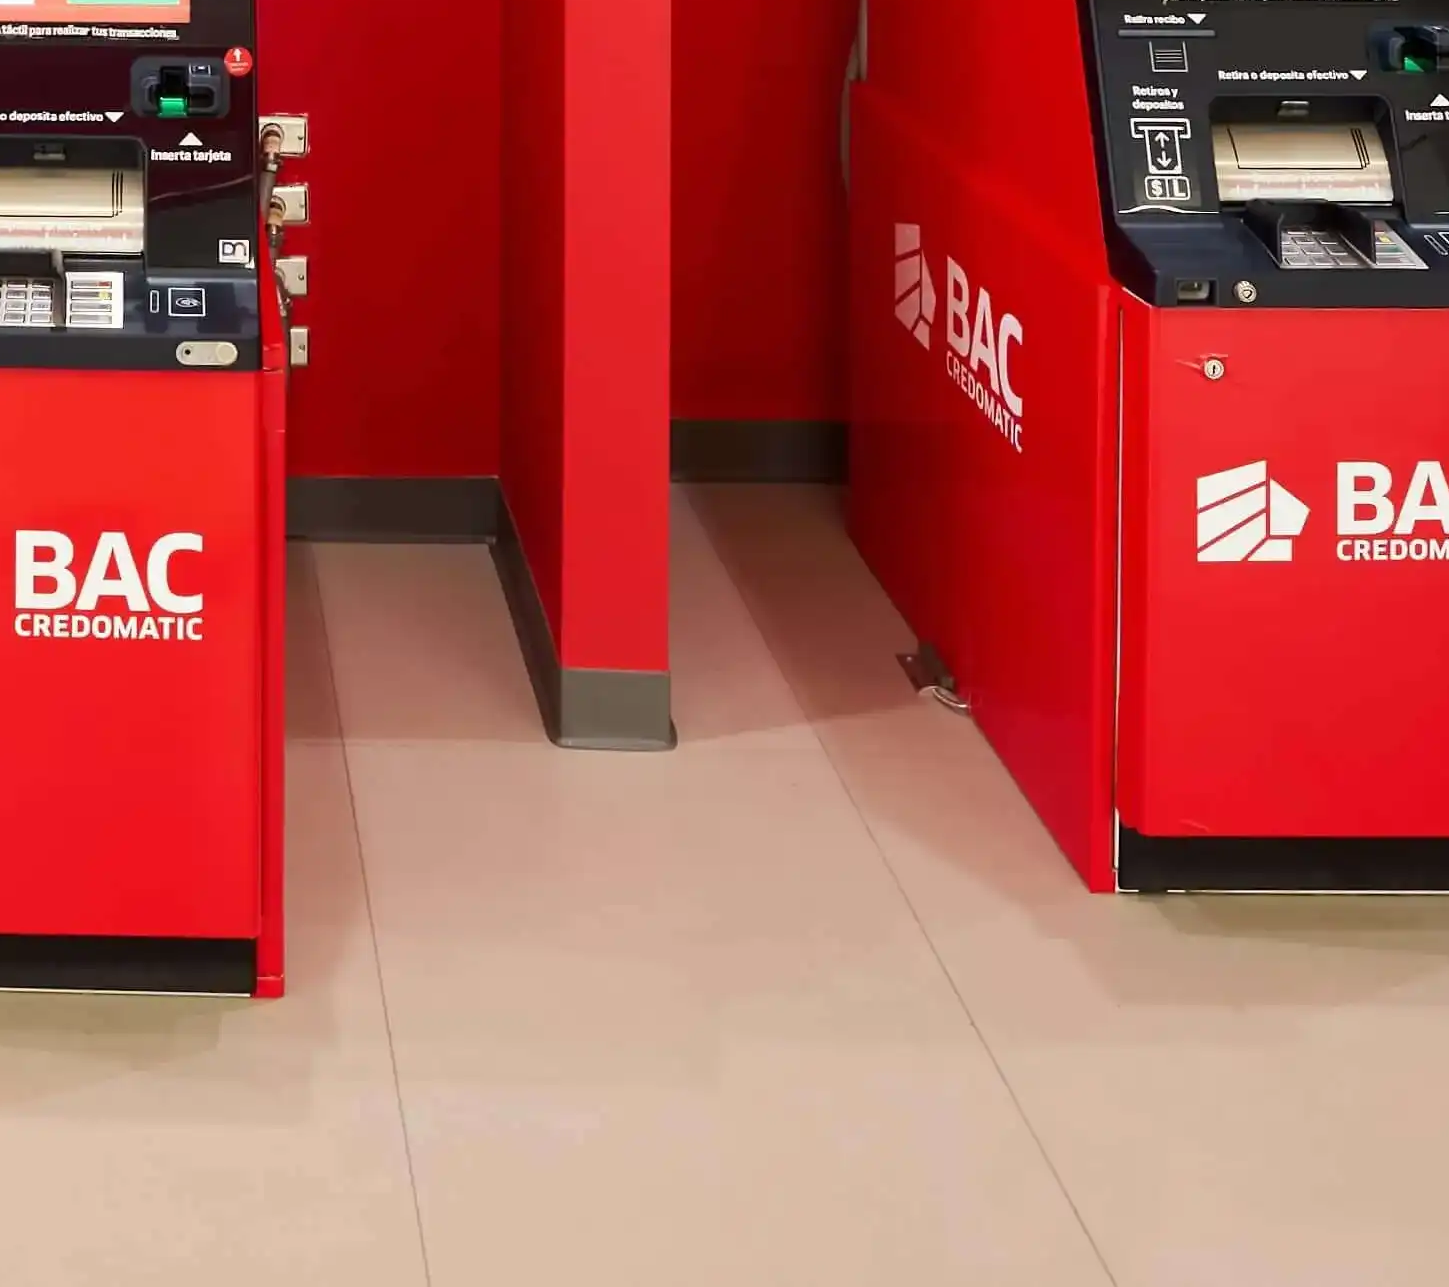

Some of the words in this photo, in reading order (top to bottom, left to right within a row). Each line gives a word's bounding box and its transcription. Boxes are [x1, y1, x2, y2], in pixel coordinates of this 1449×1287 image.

[1154, 14, 1185, 25] recibo
[92, 26, 108, 37] tus
[1218, 70, 1250, 81] Retira
[1306, 70, 1349, 81] efectivo
[1132, 85, 1170, 96] Retiros
[1171, 88, 1179, 98] y
[0, 113, 8, 122] o
[9, 111, 58, 125] deposita
[59, 111, 104, 123] efectivo
[1405, 110, 1444, 122] Inserta
[150, 149, 192, 162] Inserta
[193, 149, 232, 163] tarjeta
[1150, 178, 1163, 198] $
[1172, 178, 1186, 197] L
[946, 254, 1023, 418] BAC
[945, 354, 1023, 453] CREDOMATIC
[14, 529, 204, 614] BAC
[14, 613, 204, 641] CREDOMATIC
